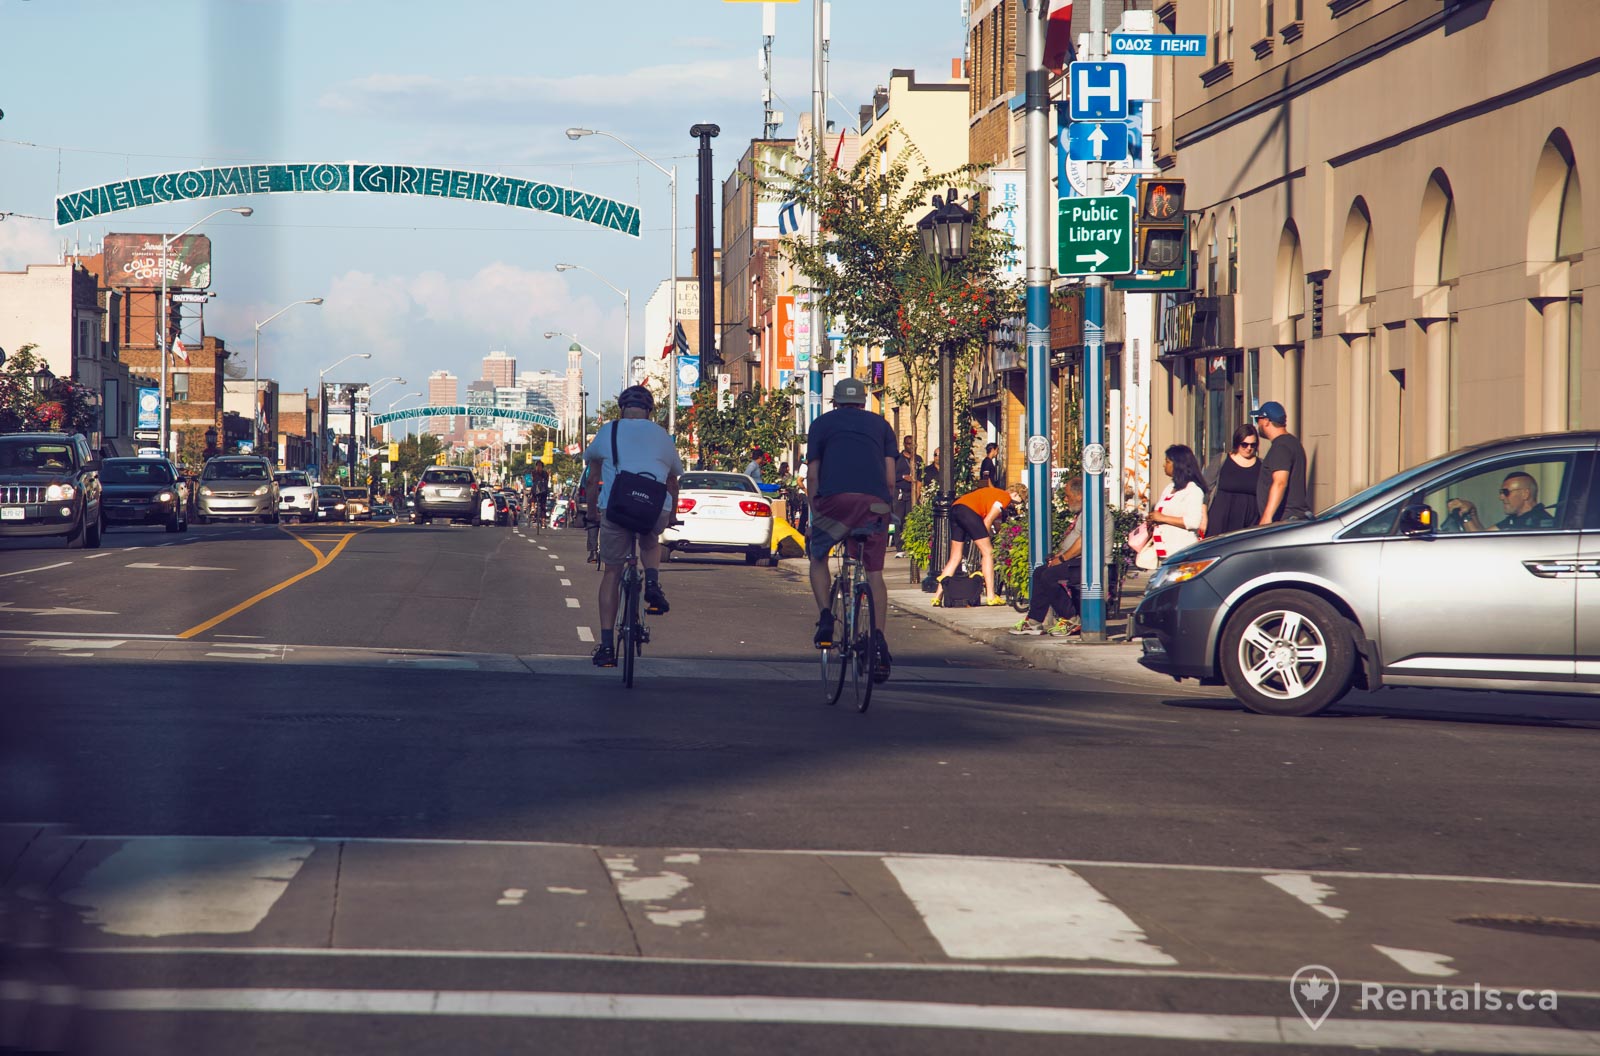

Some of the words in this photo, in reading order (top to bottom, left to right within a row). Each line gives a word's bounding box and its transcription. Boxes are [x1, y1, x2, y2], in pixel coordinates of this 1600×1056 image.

[1115, 38, 1152, 51] ΟΔΟΣ
[1160, 39, 1200, 52] ΠΕΗΠ
[1078, 69, 1120, 112] H
[1070, 161, 1086, 188] GREEKT
[61, 165, 271, 222] WELCOME
[286, 163, 343, 193] TO
[359, 164, 636, 234] GREEKTOWN
[1072, 206, 1119, 222] Public
[1004, 183, 1017, 272] RESTAUNT
[1069, 227, 1122, 244] Library
[123, 258, 155, 273] COLD
[158, 258, 192, 274] BREW
[134, 268, 180, 281] COFFEE
[685, 283, 699, 291] FO
[679, 293, 698, 301] LEA
[373, 407, 426, 427] THANK
[430, 405, 462, 416] YOU
[467, 406, 495, 417] FOR
[499, 407, 560, 430] VISITING
